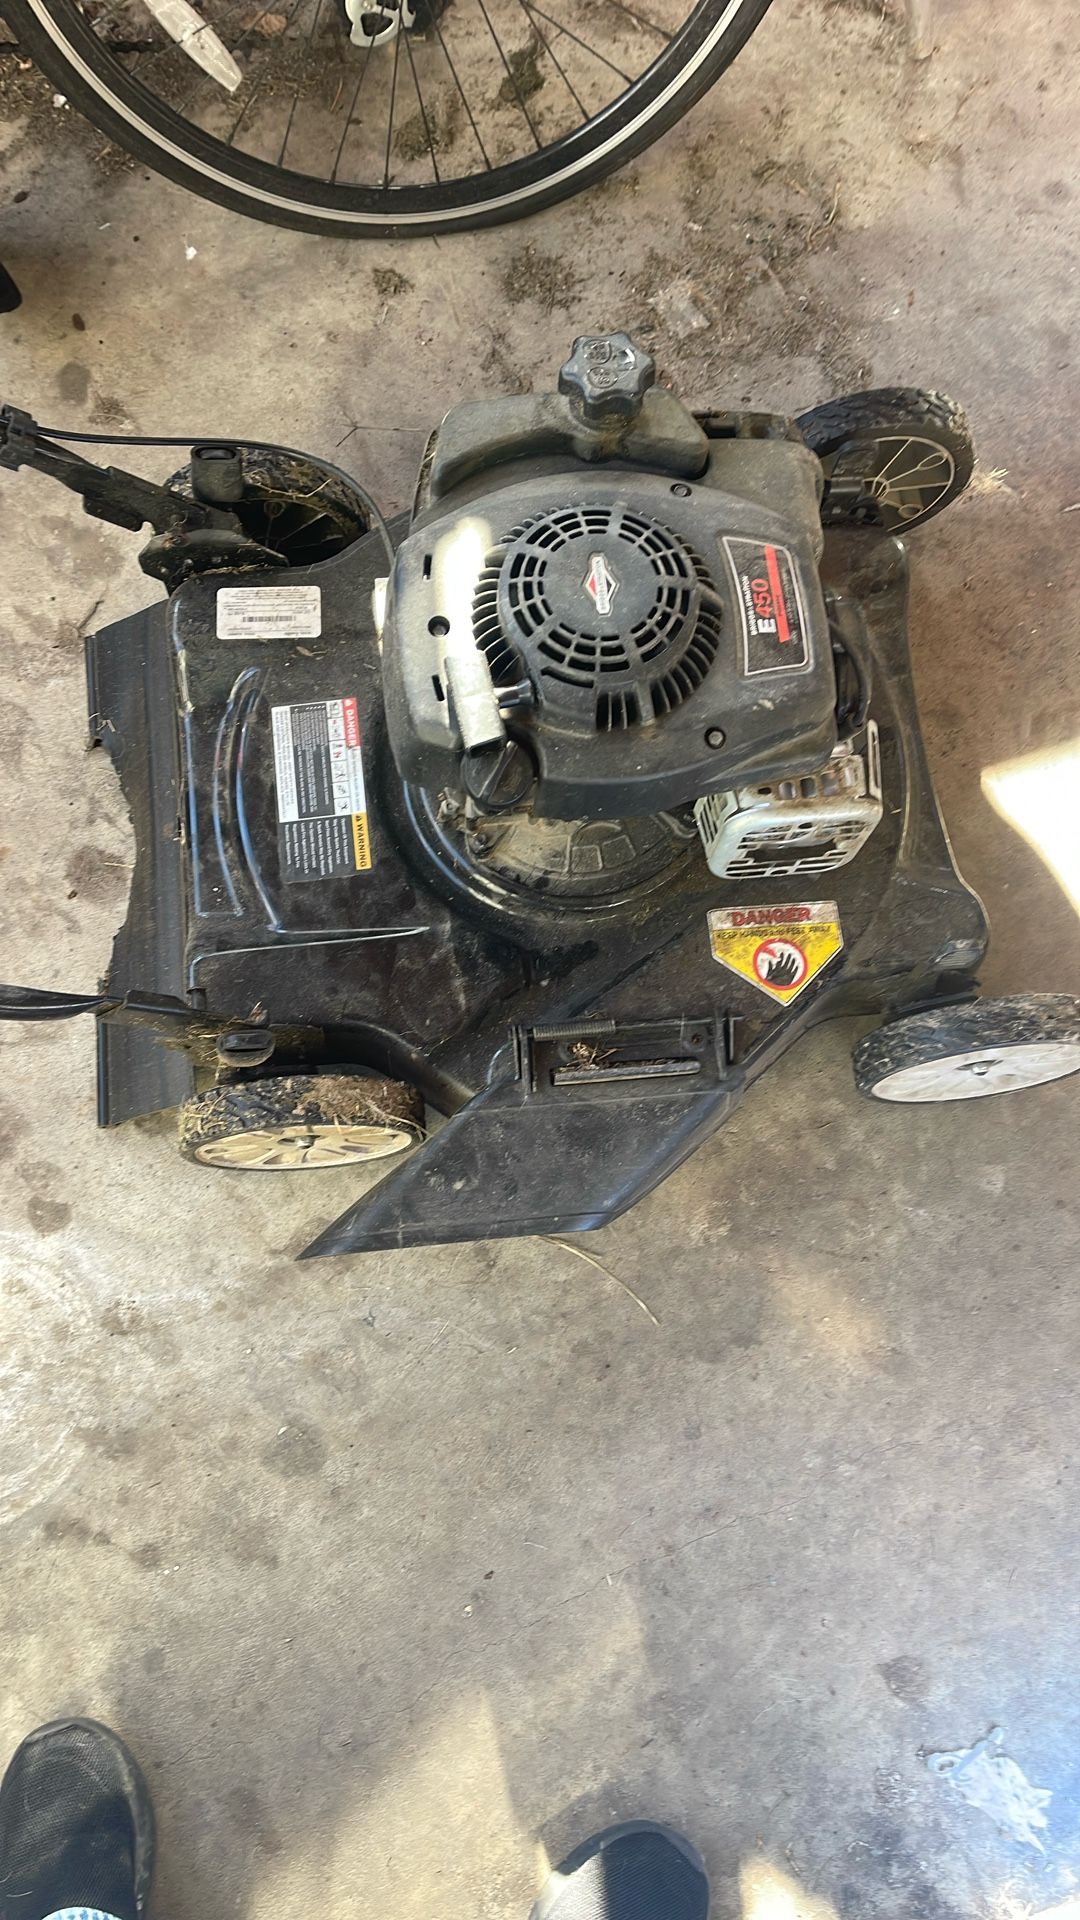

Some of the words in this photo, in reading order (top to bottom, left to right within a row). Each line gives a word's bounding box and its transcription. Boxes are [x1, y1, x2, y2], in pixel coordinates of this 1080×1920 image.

[751, 578, 777, 633] E450
[346, 709, 358, 747] DANGER
[356, 823, 367, 868] WARNING
[731, 907, 811, 927] DANGER
